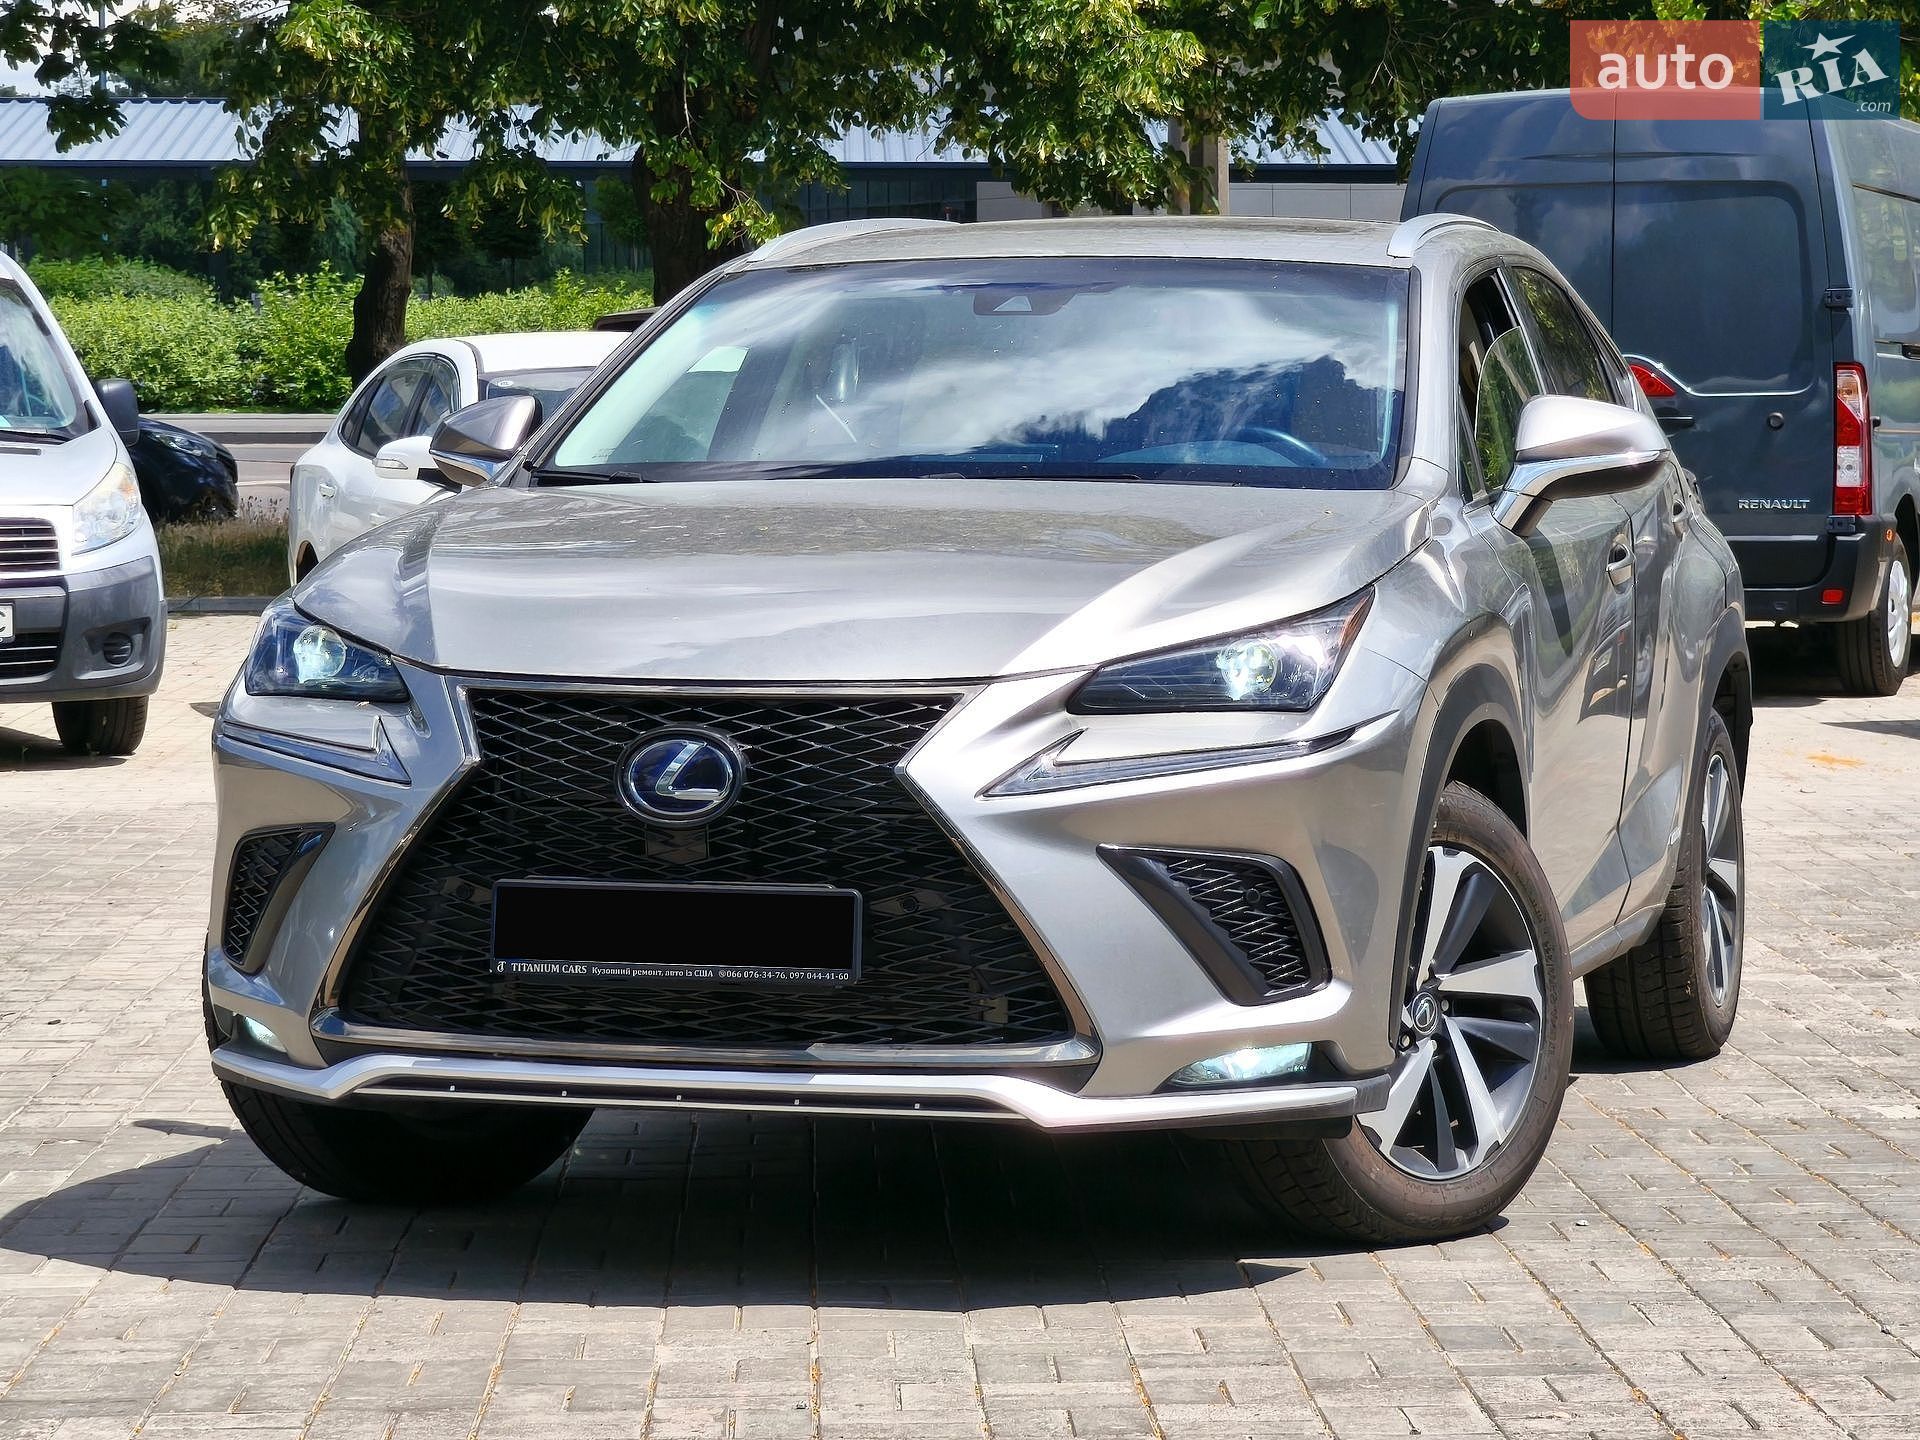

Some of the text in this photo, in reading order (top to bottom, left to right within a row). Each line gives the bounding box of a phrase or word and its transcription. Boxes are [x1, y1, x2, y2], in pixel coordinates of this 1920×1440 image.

[1738, 499, 1810, 509] RENAULT
[511, 962, 588, 974] TITANIUM CARS
[592, 966, 631, 976] Кузовний
[726, 970, 741, 978] 066
[789, 971, 805, 979] 097
